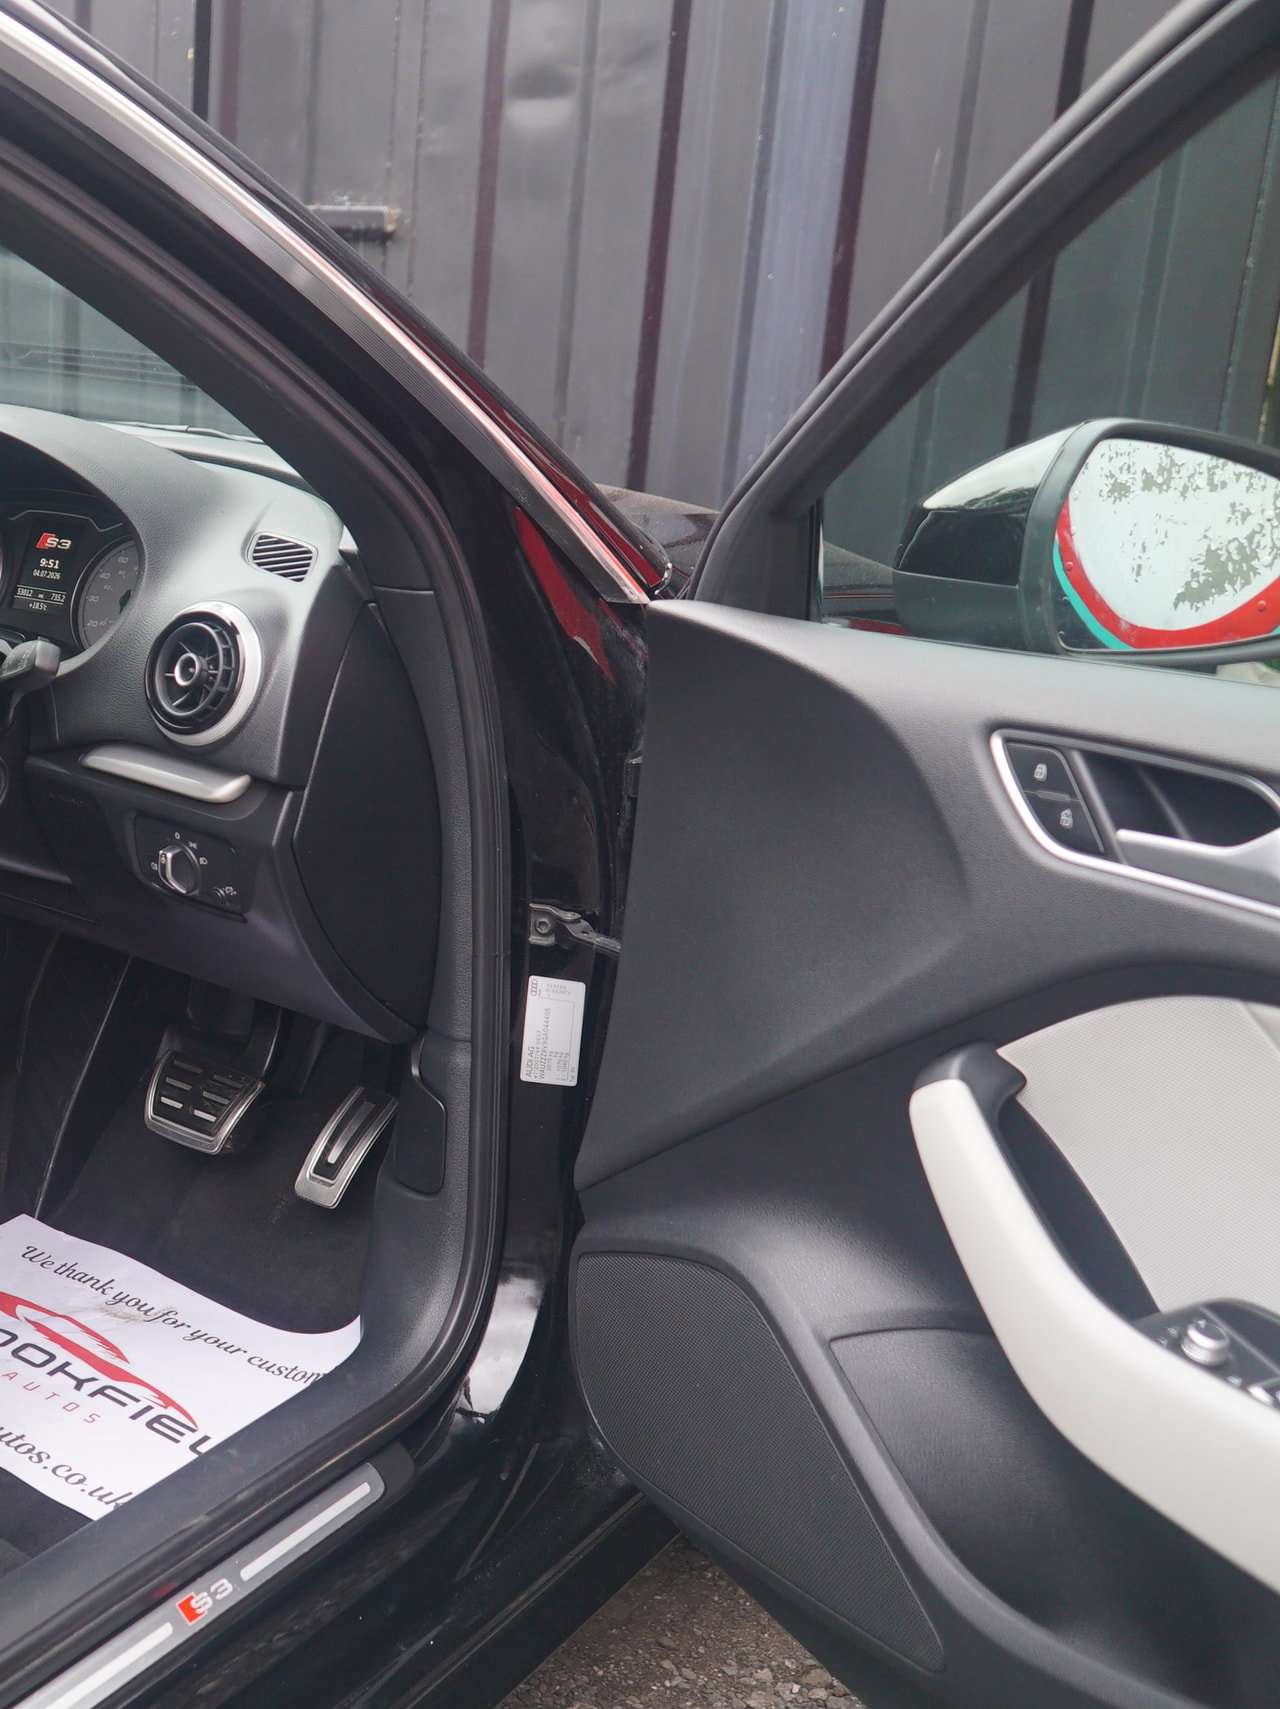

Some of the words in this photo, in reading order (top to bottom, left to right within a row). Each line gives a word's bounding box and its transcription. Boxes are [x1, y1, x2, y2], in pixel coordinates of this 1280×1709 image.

[41, 534, 72, 550] S3
[39, 558, 60, 569] 9:51
[21, 1245, 55, 1270] We
[53, 1262, 115, 1296] thank
[105, 1291, 155, 1317] you
[143, 1310, 192, 1329] for
[182, 1329, 248, 1355] your
[1, 1371, 101, 1424] AUTOS
[183, 1577, 234, 1618] S3
